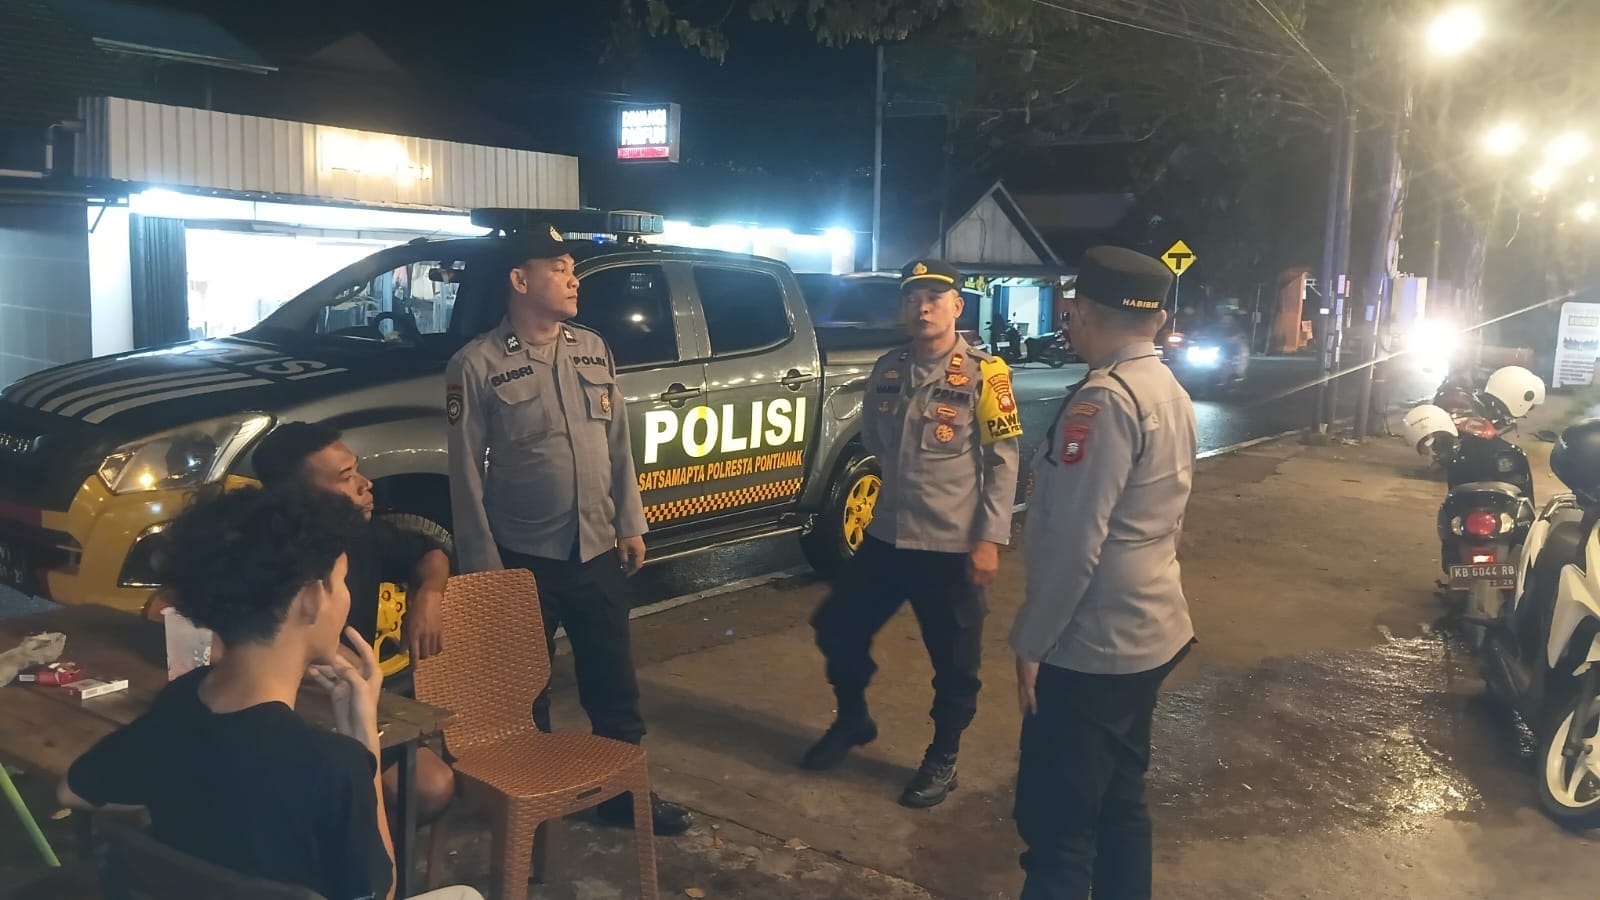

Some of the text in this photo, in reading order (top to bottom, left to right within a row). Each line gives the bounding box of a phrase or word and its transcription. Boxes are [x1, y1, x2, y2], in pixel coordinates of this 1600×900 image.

[573, 355, 606, 367] POLRI
[644, 397, 807, 464] POLISI
[987, 413, 1020, 432] PAW
[638, 449, 803, 492] SATSAMAPTA POLRESTA PONTIANAK
[1455, 567, 1469, 577] KB
[1472, 566, 1497, 577] 6044
